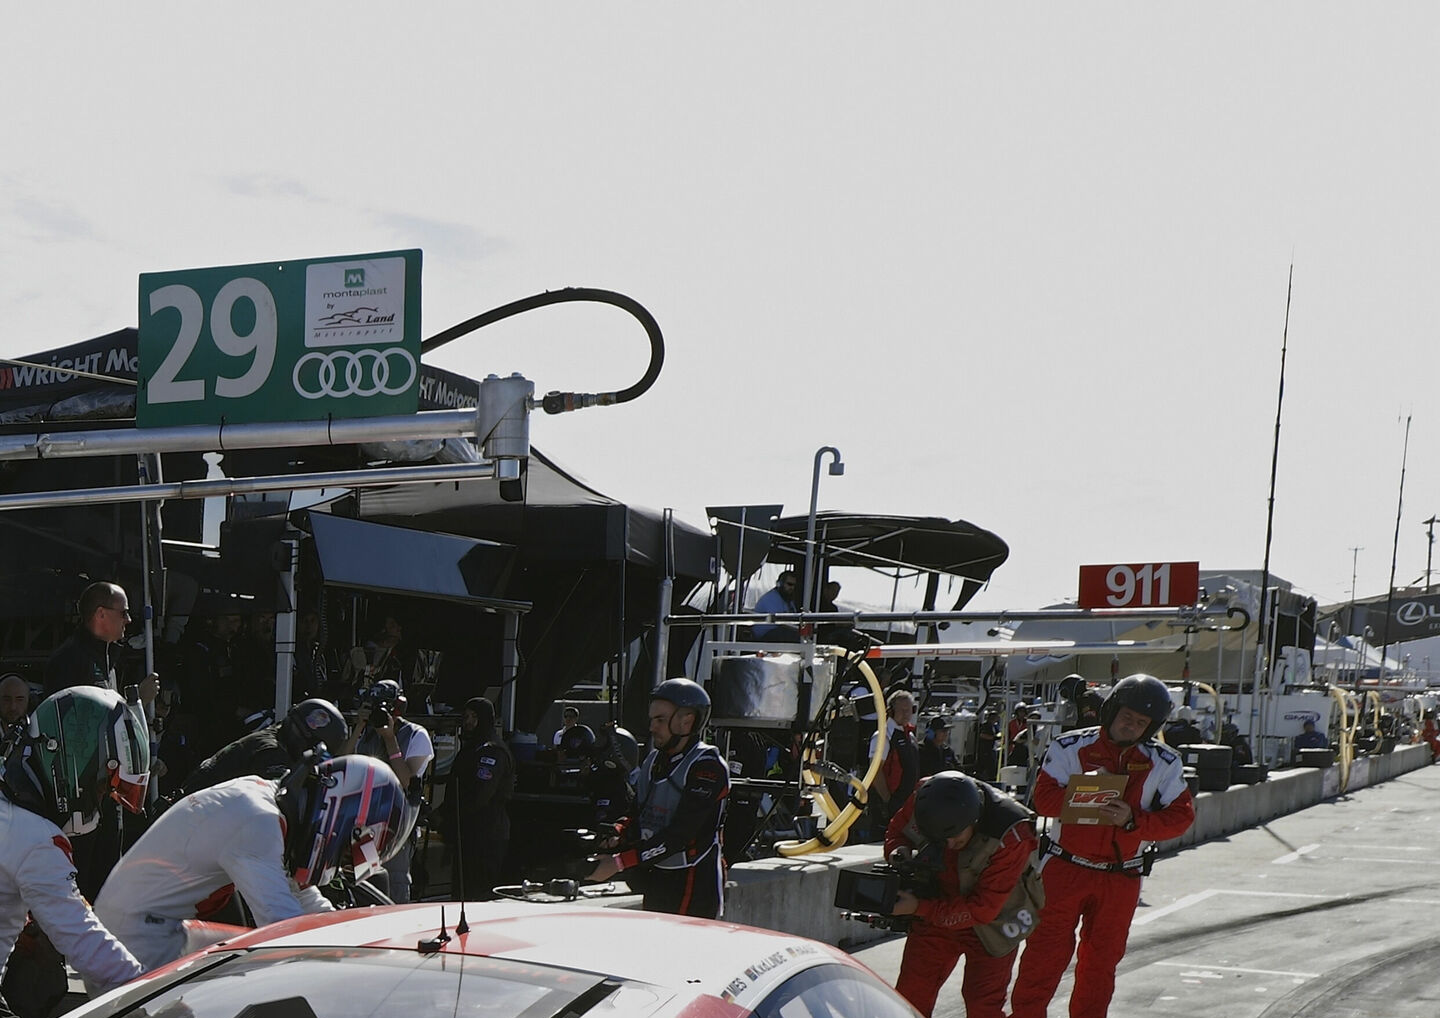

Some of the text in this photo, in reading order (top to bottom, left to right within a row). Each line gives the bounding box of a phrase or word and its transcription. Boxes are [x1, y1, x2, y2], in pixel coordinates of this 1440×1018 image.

[323, 287, 388, 299] montaplast
[366, 313, 396, 324] Land
[146, 277, 279, 404] 29
[1105, 563, 1171, 607] 911
